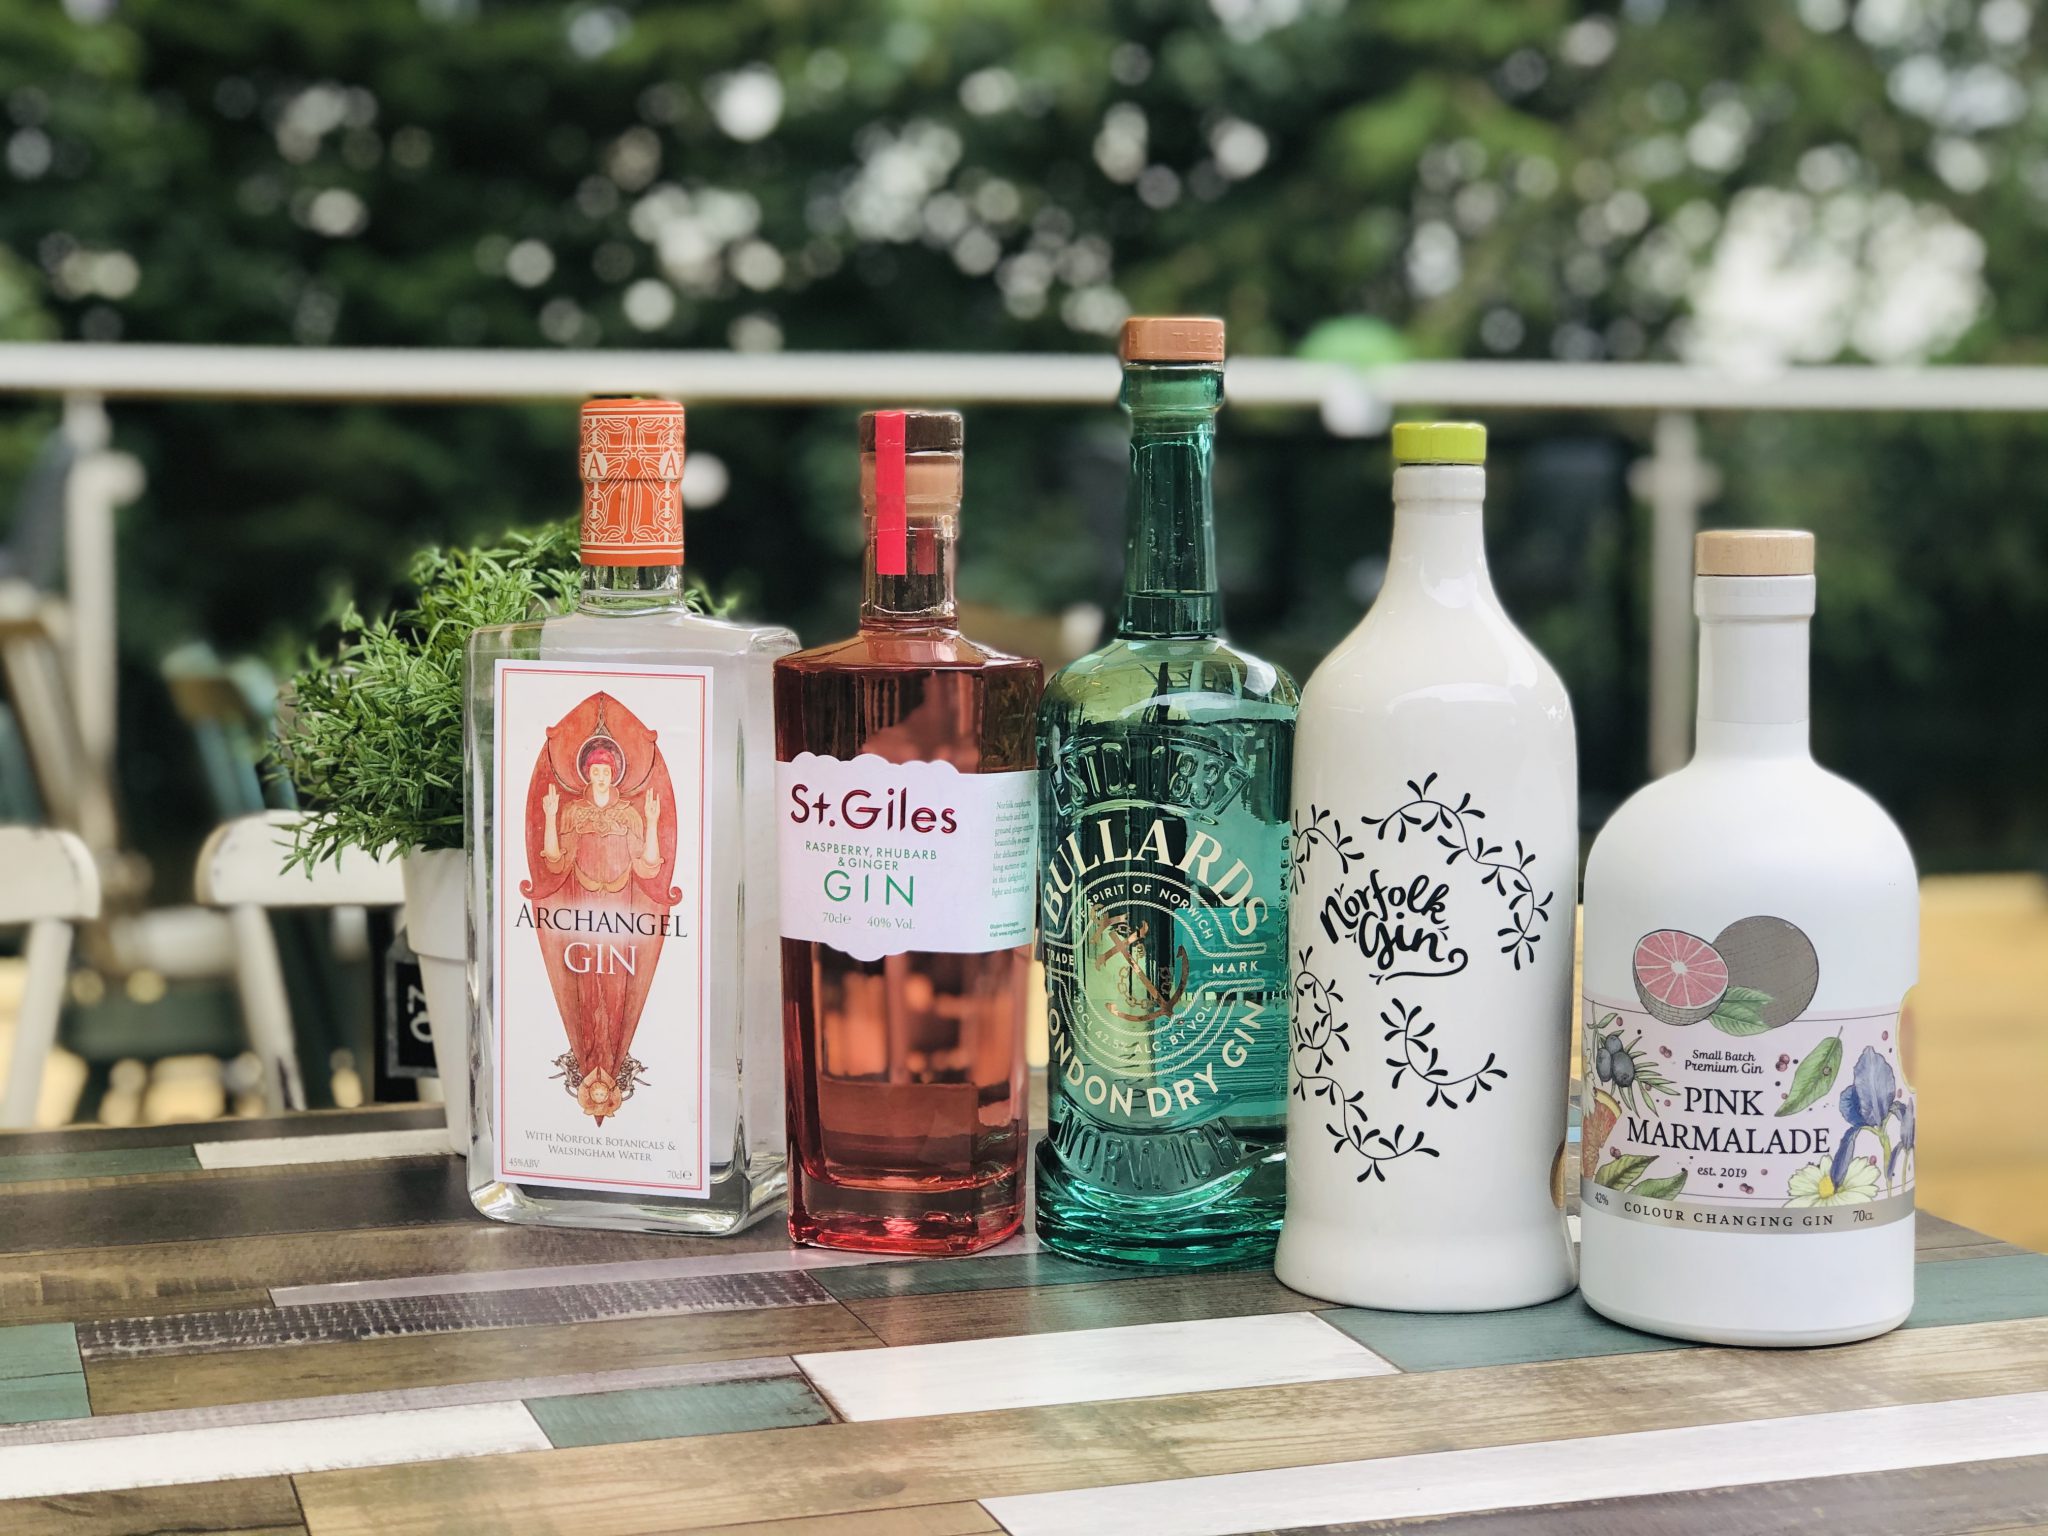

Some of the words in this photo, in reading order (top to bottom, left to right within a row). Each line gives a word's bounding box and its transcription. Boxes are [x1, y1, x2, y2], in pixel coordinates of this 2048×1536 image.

[587, 456, 604, 477] A
[663, 456, 678, 477] A
[805, 840, 873, 859] RASPBERRY,
[876, 847, 937, 860] RHUBARB
[837, 857, 845, 867] &
[848, 857, 899, 871] GINGER
[823, 869, 914, 907] GIN
[1043, 818, 1269, 937] BULLARDS
[1087, 884, 1125, 907] SPIRIT
[1132, 883, 1152, 895] OF
[1158, 887, 1214, 940] NORWICH
[1320, 869, 1450, 944] Norfolk
[514, 902, 688, 938] ARCHANGEL
[867, 915, 892, 928] 40%
[563, 942, 638, 977] GIN
[1046, 949, 1075, 966] TRADE
[1212, 960, 1258, 974] MARK
[1134, 1041, 1167, 1054] ALC.
[1169, 1029, 1186, 1046] BY
[1048, 990, 1134, 1118] ONDON
[1146, 1062, 1219, 1118] DRY
[1222, 1000, 1266, 1068] GIN
[1692, 1049, 1721, 1061] Small
[1724, 1050, 1756, 1063] Batch
[1684, 1060, 1737, 1074] Premium
[1741, 1062, 1764, 1075] Gin
[1683, 1086, 1765, 1117] PINK
[525, 1129, 552, 1142] WITH
[555, 1133, 602, 1146] NORFOLK
[605, 1136, 665, 1151] BOTANICALS
[667, 1141, 676, 1151] &
[1627, 1116, 1831, 1155] MARMALADE
[547, 1144, 616, 1160] WALSINGHAM
[618, 1150, 652, 1163] WATER
[1697, 1166, 1717, 1178] est.
[1720, 1167, 1748, 1179] 2019
[1623, 1201, 1685, 1222] COLOUR
[1693, 1212, 1794, 1228] CHANGING
[1802, 1213, 1834, 1227] GIN
